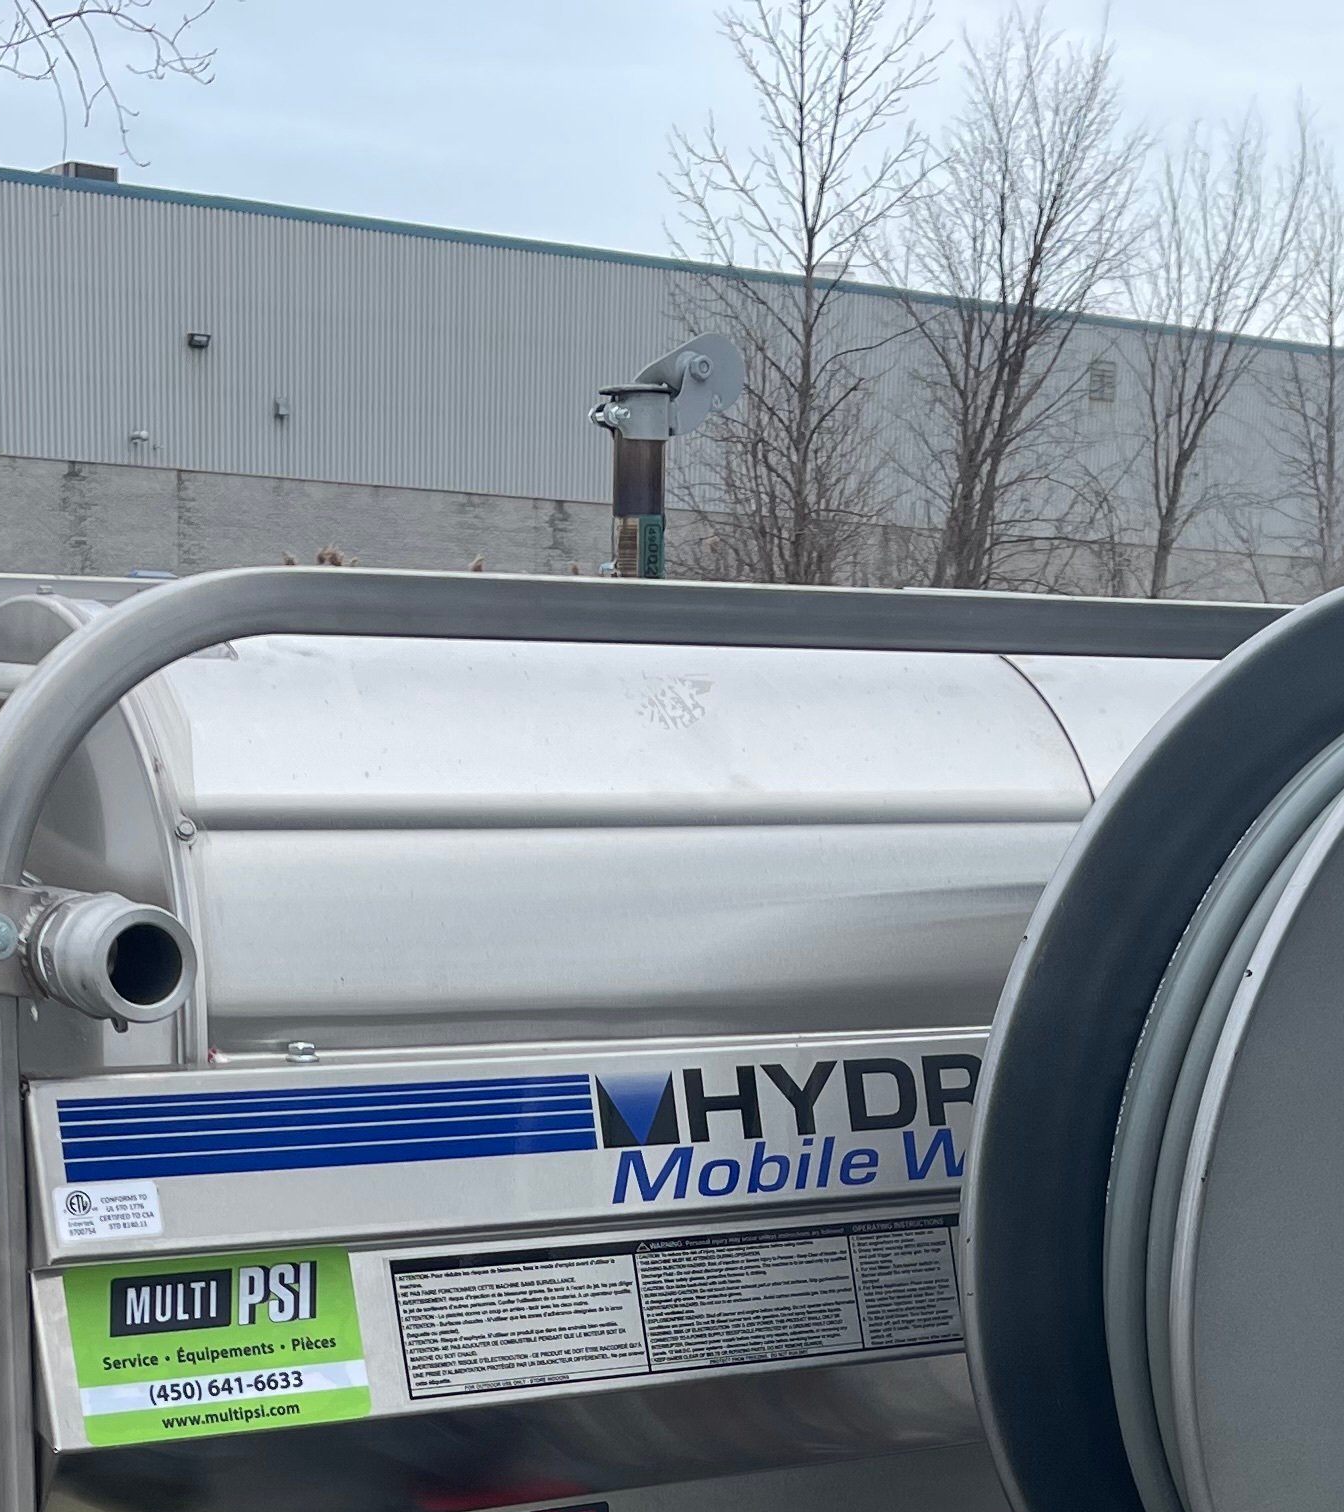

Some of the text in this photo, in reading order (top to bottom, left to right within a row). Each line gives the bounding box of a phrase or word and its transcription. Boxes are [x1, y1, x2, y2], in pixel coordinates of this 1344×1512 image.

[611, 1136, 880, 1204] Mobile
[125, 1260, 317, 1326] MULTI PSI
[103, 1336, 336, 1370] Service Équipements Pièces
[149, 1370, 304, 1406] (450) 641-6633
[162, 1402, 301, 1429] www.multipsi.com
